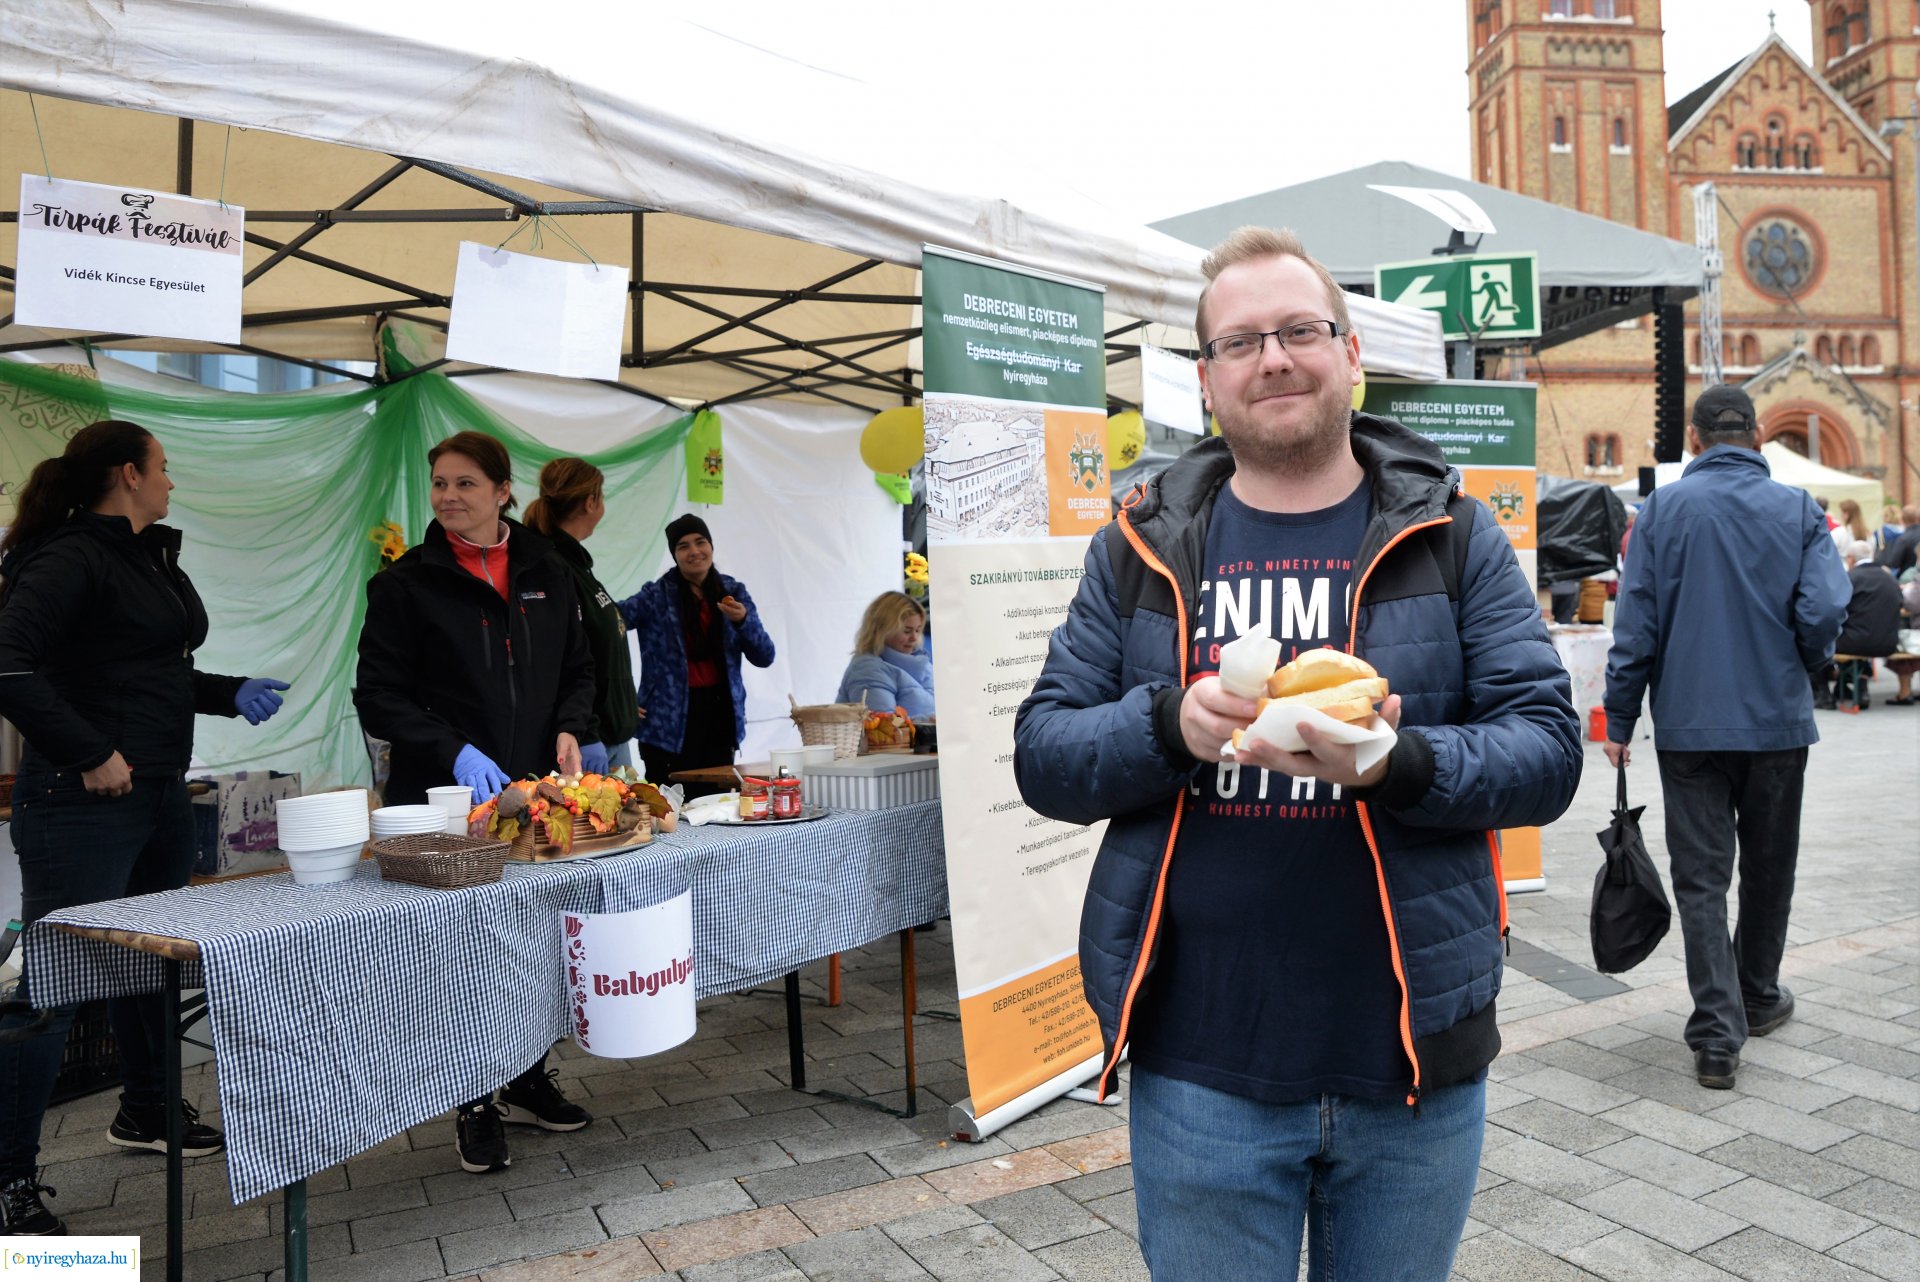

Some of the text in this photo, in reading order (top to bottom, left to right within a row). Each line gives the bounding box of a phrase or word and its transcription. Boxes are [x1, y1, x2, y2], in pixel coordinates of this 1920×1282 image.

[24, 204, 240, 250] Tirpák Fesztivál
[64, 267, 206, 293] Vidék Kincse Egyesület
[963, 293, 1079, 330] DEBRECENI EGYETEM
[943, 313, 1098, 349] nemzetközileg elismert, piacképes diploma
[966, 341, 1082, 373] Egészségtudományi Kar
[1390, 401, 1506, 416] DEBRECENI EGYETEM
[1401, 415, 1419, 424] mint
[1418, 430, 1506, 444] égtudományi Kar
[1265, 559, 1321, 572] NINETY
[1326, 559, 1356, 571] NIN
[1044, 603, 1070, 615] konzultá
[1194, 577, 1330, 641] ENIM
[992, 703, 1020, 717] Életvez
[1208, 802, 1348, 818] HIGHEST QUALITY
[593, 948, 694, 997] Babgulyá
[993, 987, 1034, 1013] DEBRECENI
[1035, 971, 1065, 995] EGYETEM
[1021, 1000, 1037, 1014] 4400
